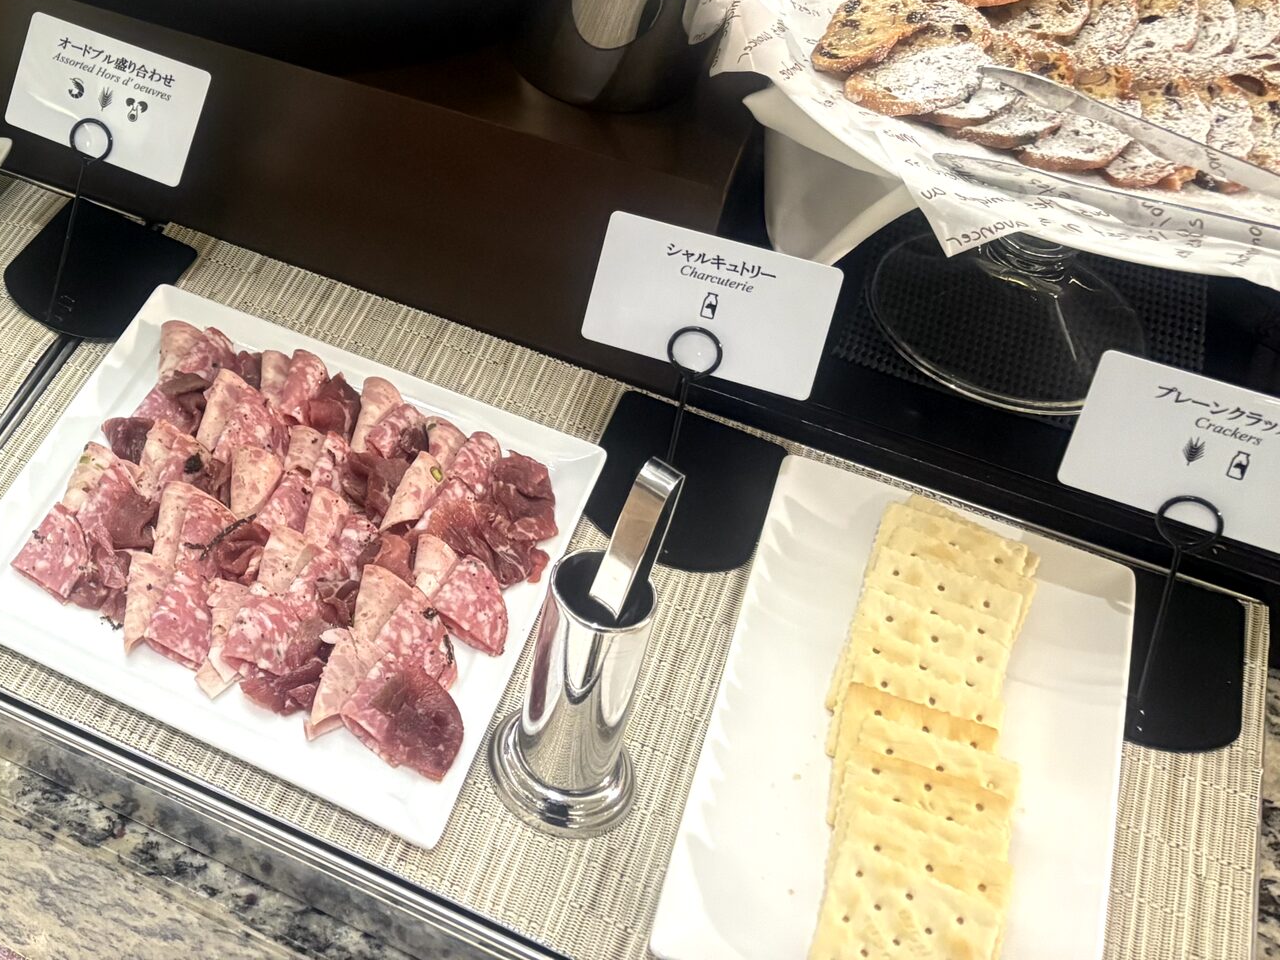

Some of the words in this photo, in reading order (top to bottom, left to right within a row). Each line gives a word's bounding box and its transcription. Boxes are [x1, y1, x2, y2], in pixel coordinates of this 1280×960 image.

[52, 52, 96, 73] Assorted
[96, 67, 121, 83] Hors
[57, 37, 176, 88] オードブル盛り合わせ
[666, 243, 777, 279] シャルキュトリー
[680, 265, 754, 293] Charcuterie
[1155, 385, 1280, 436] プレーンクラッ
[1195, 417, 1263, 445] Crackers
